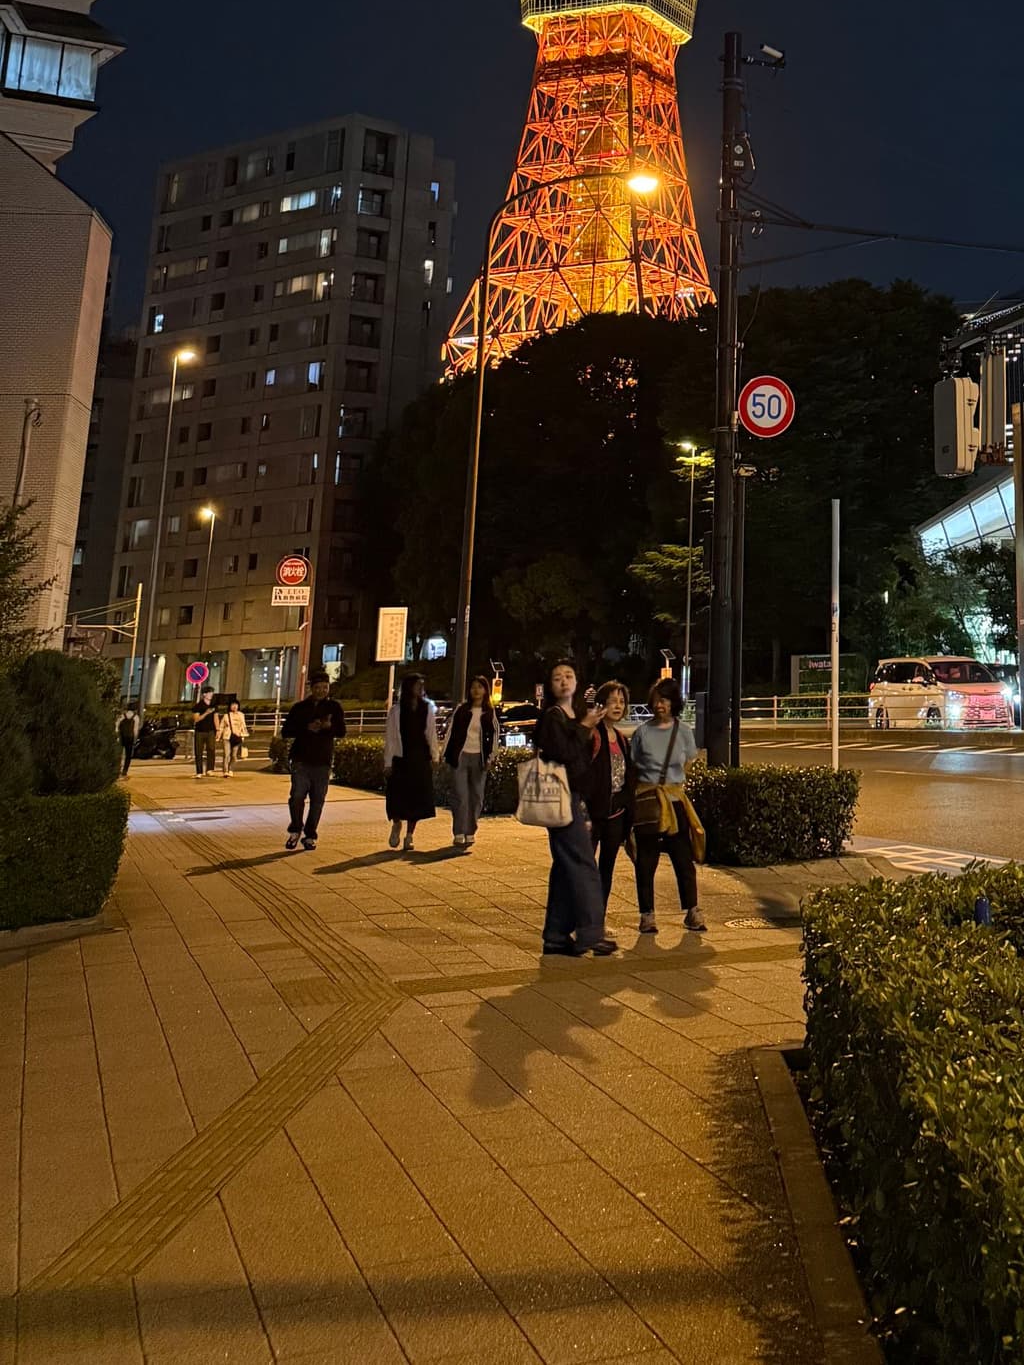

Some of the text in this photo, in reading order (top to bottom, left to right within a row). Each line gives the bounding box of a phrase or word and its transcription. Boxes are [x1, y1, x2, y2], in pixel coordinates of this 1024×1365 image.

[751, 392, 782, 420] 50
[282, 565, 305, 577] 消火栓
